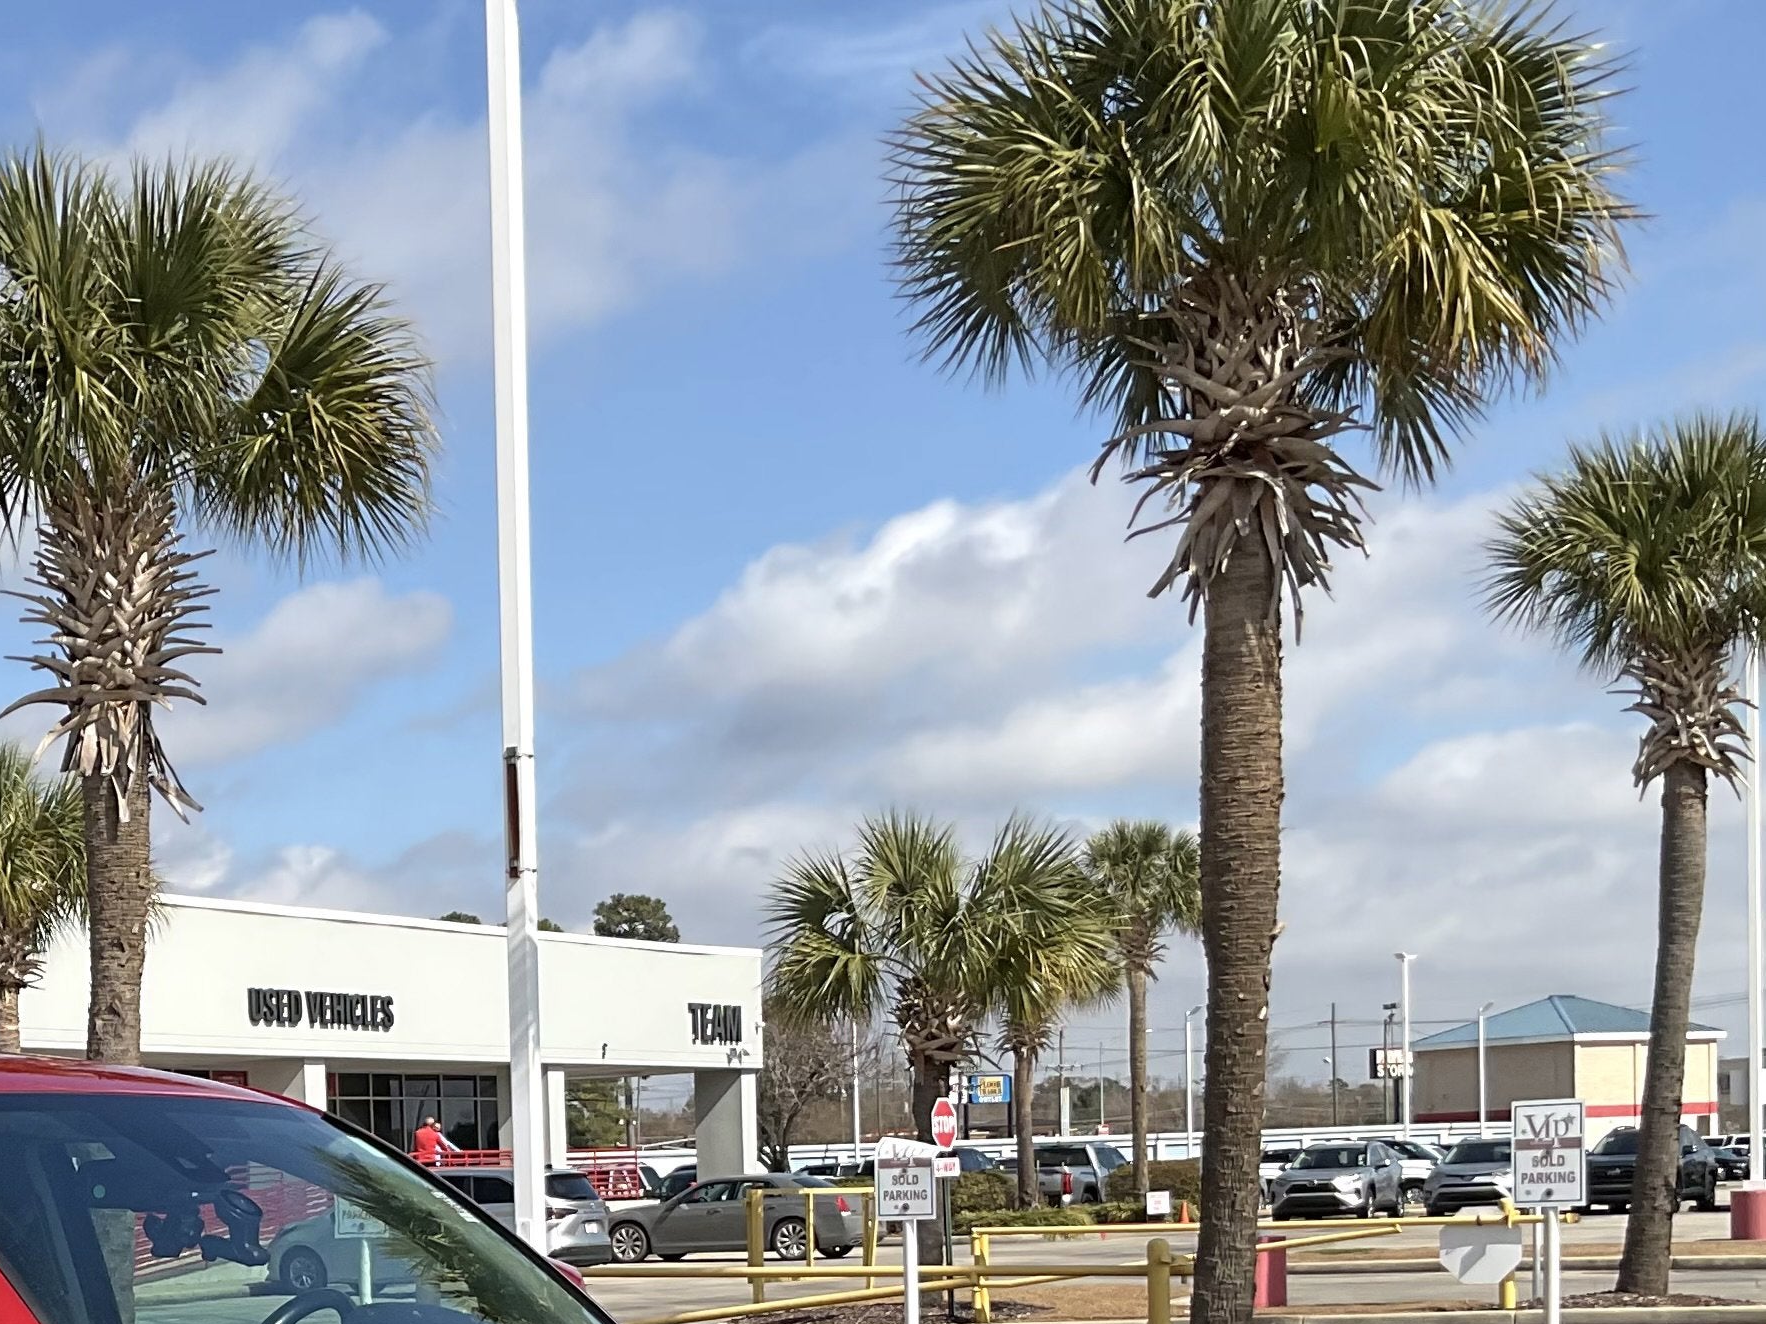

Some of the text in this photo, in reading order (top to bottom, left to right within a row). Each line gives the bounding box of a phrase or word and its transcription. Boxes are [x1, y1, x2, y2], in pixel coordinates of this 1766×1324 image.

[247, 987, 395, 1032] USED VEHICLES
[687, 1003, 742, 1046] TEAM
[933, 1115, 955, 1134] STOP
[1532, 1154, 1565, 1168] SOLD
[891, 1174, 919, 1186] SOLD
[1521, 1171, 1576, 1185] PARKING
[883, 1189, 928, 1201] PARKING
